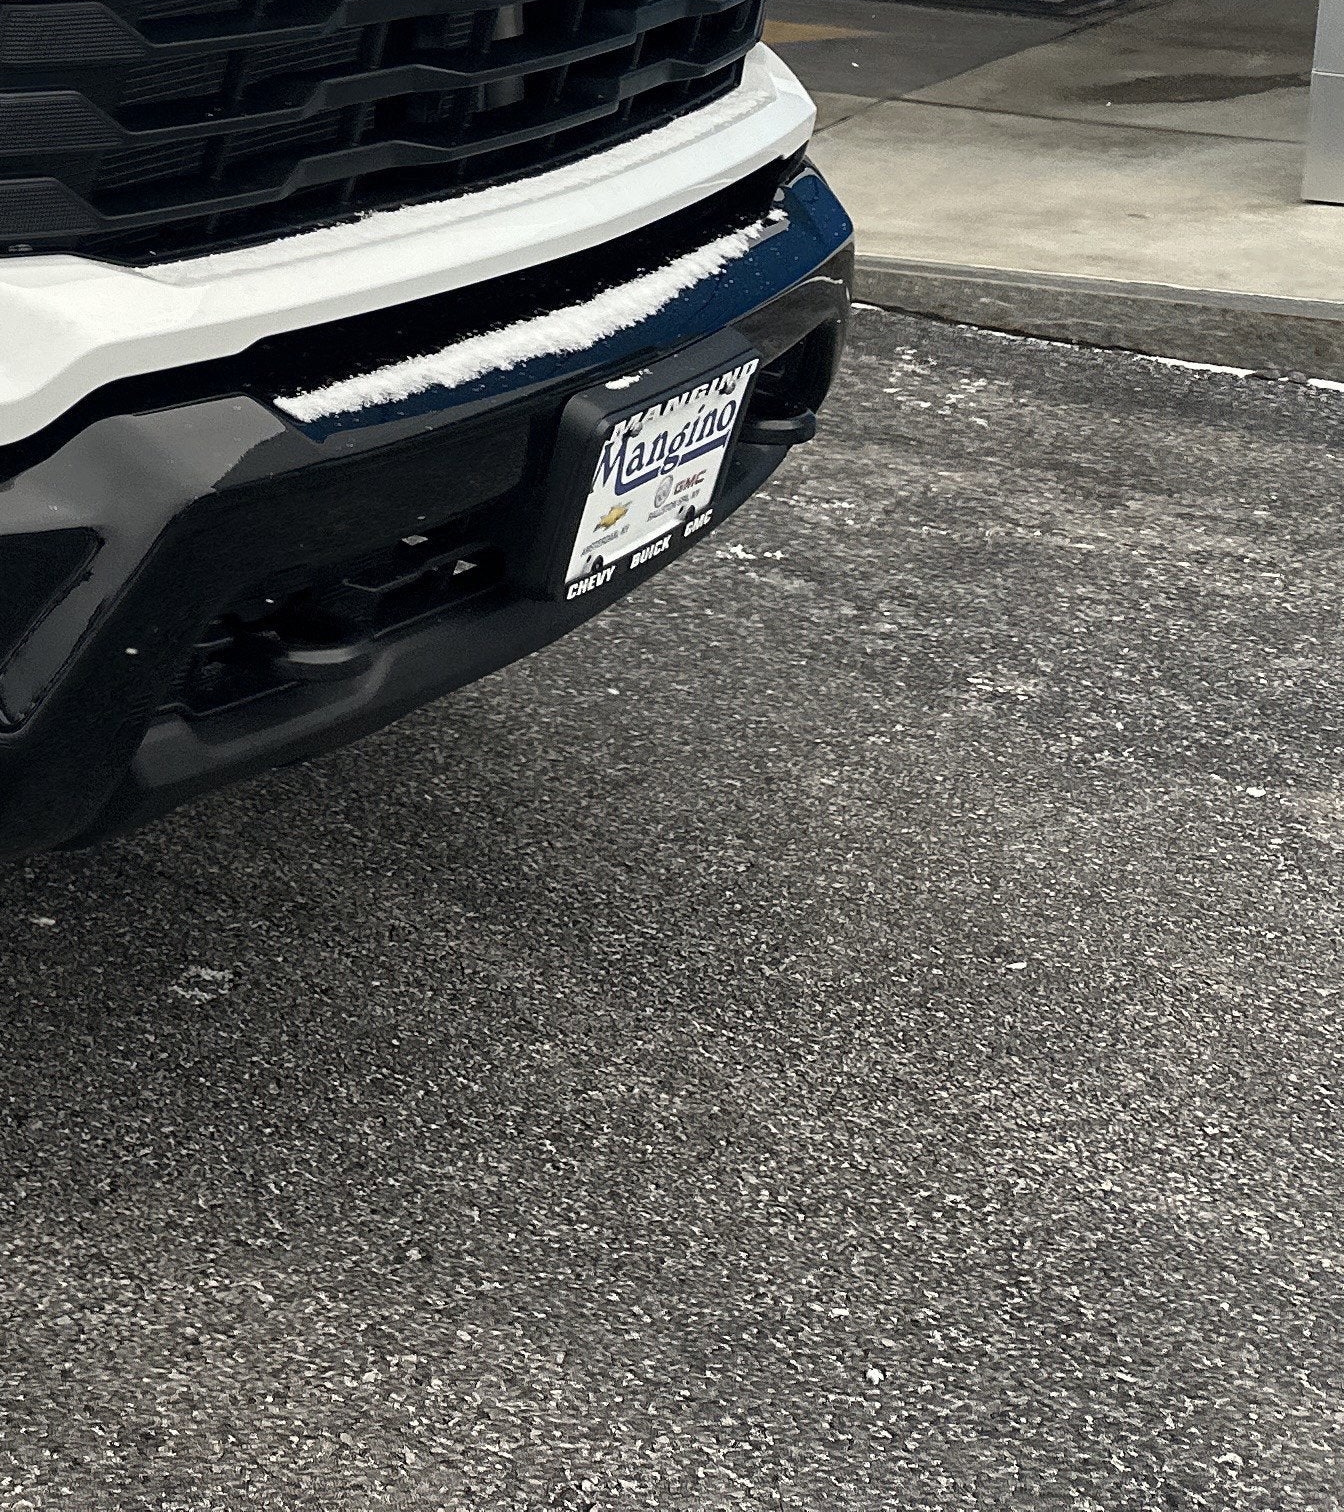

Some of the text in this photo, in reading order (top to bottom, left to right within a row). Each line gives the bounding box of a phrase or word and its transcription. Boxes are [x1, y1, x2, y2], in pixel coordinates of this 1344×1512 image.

[592, 399, 738, 496] Mangino
[566, 564, 616, 601] CHEVY
[629, 533, 673, 570] BUICK
[683, 508, 714, 538] GMC
